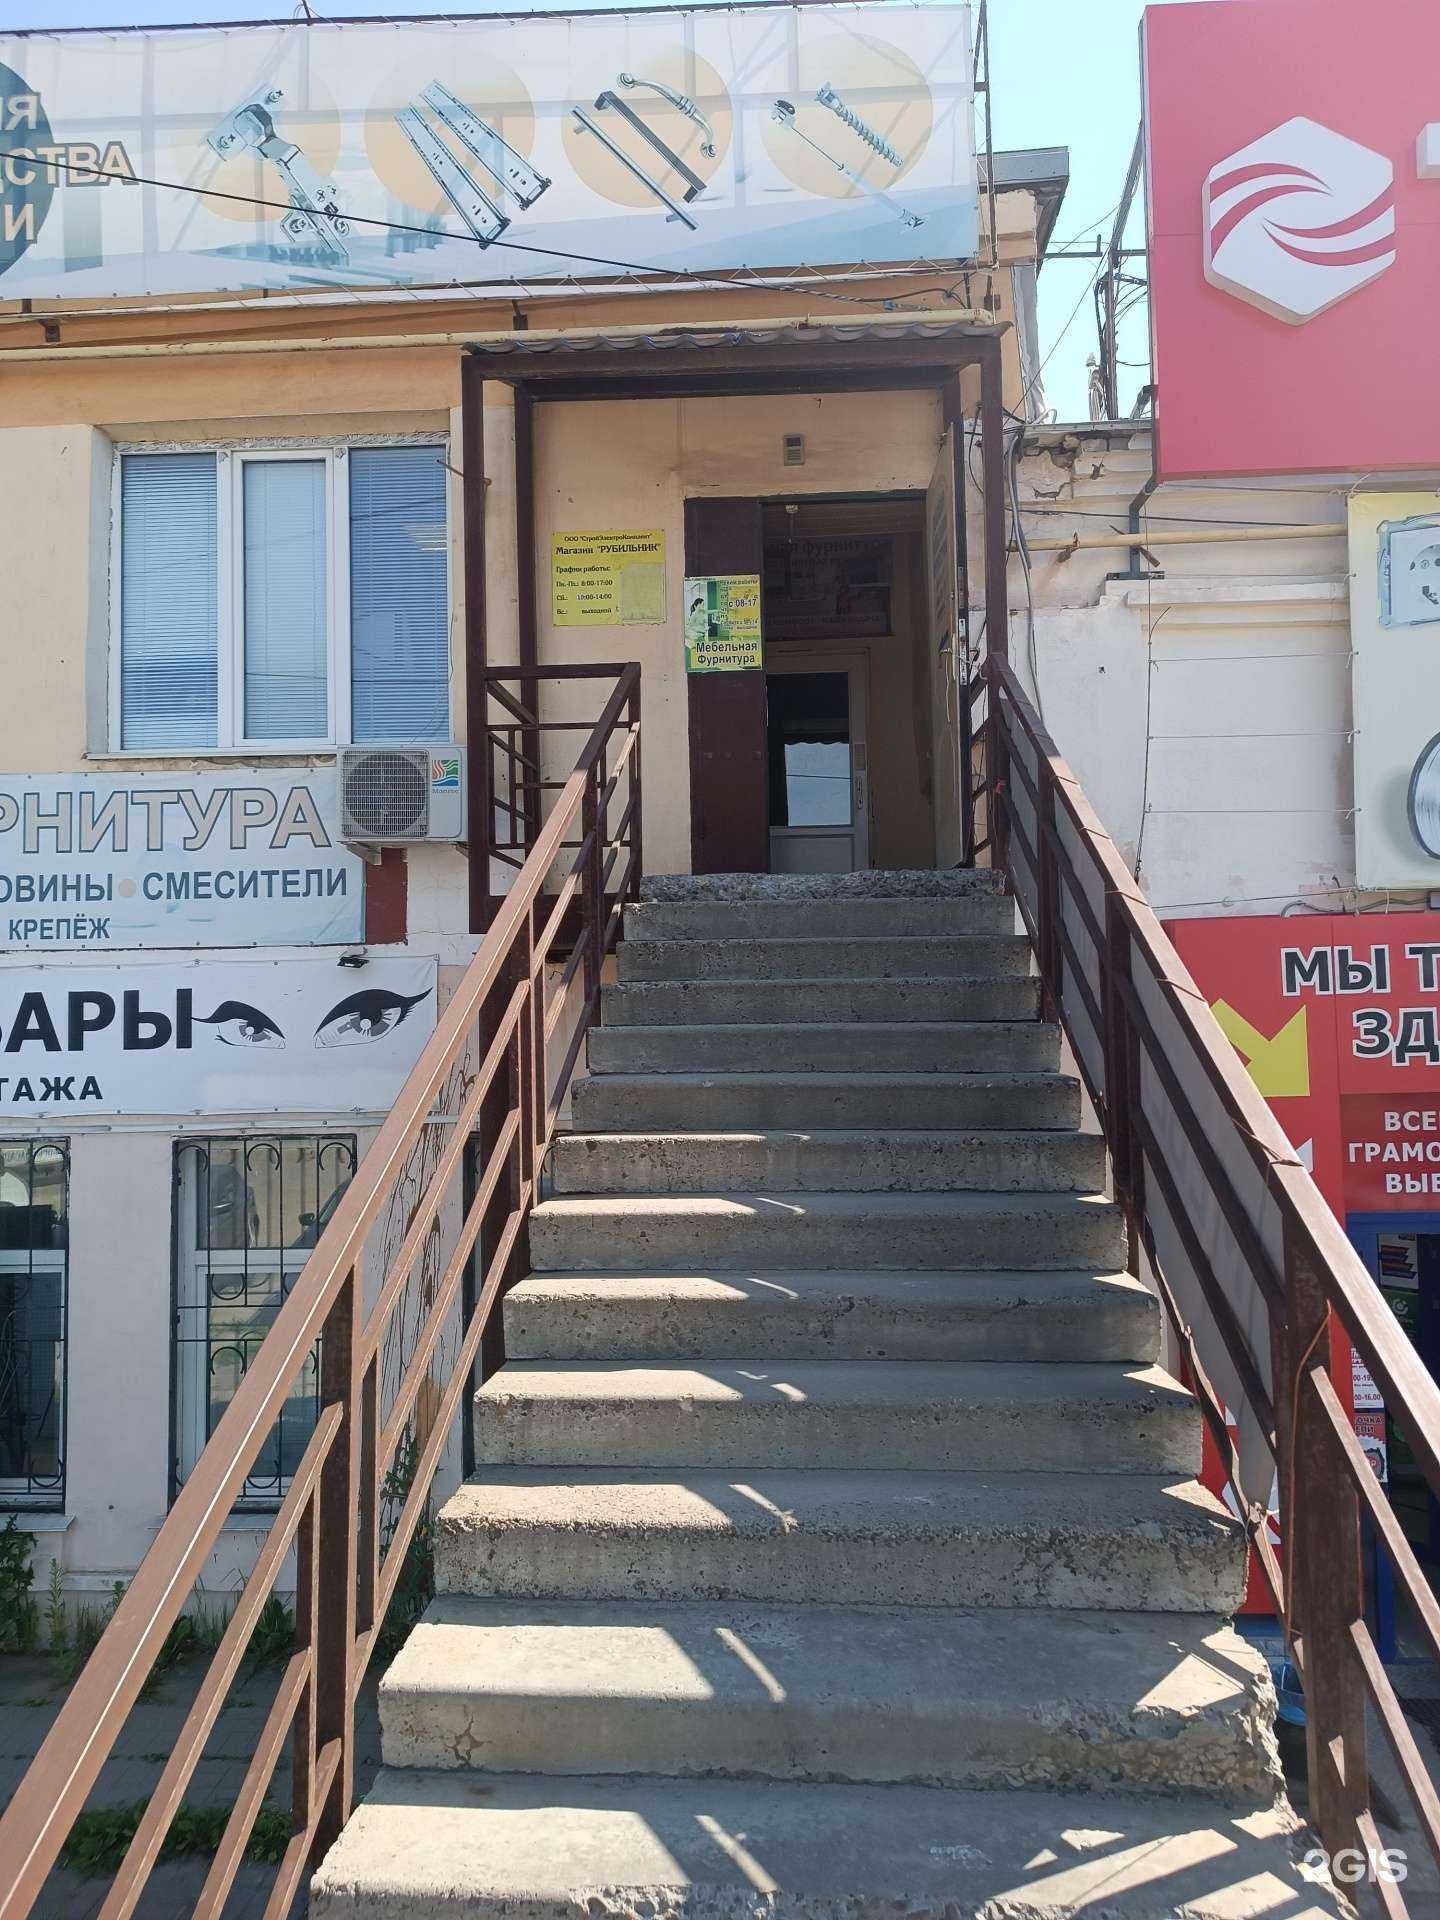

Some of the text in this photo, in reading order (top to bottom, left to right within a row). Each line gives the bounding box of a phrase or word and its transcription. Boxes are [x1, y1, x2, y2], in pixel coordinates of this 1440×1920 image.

[0, 92, 40, 131] Я
[0, 141, 139, 190] СТВА
[598, 543, 661, 553] "РУБИЛЬНИК"
[735, 599, 757, 607] 08-17
[696, 642, 758, 653] Мебельная
[697, 655, 755, 666] Фурнитура
[143, 867, 347, 901] СМЕСИТЕЛИ
[9, 913, 111, 940] КРЕПЁЖ
[1280, 944, 1391, 997] МЫ
[0, 988, 193, 1053] АРЫ
[1352, 1006, 1440, 1067] ЗД
[1384, 1110, 1440, 1132] ВСЕ
[1355, 1416, 1383, 1424] ОЧКА
